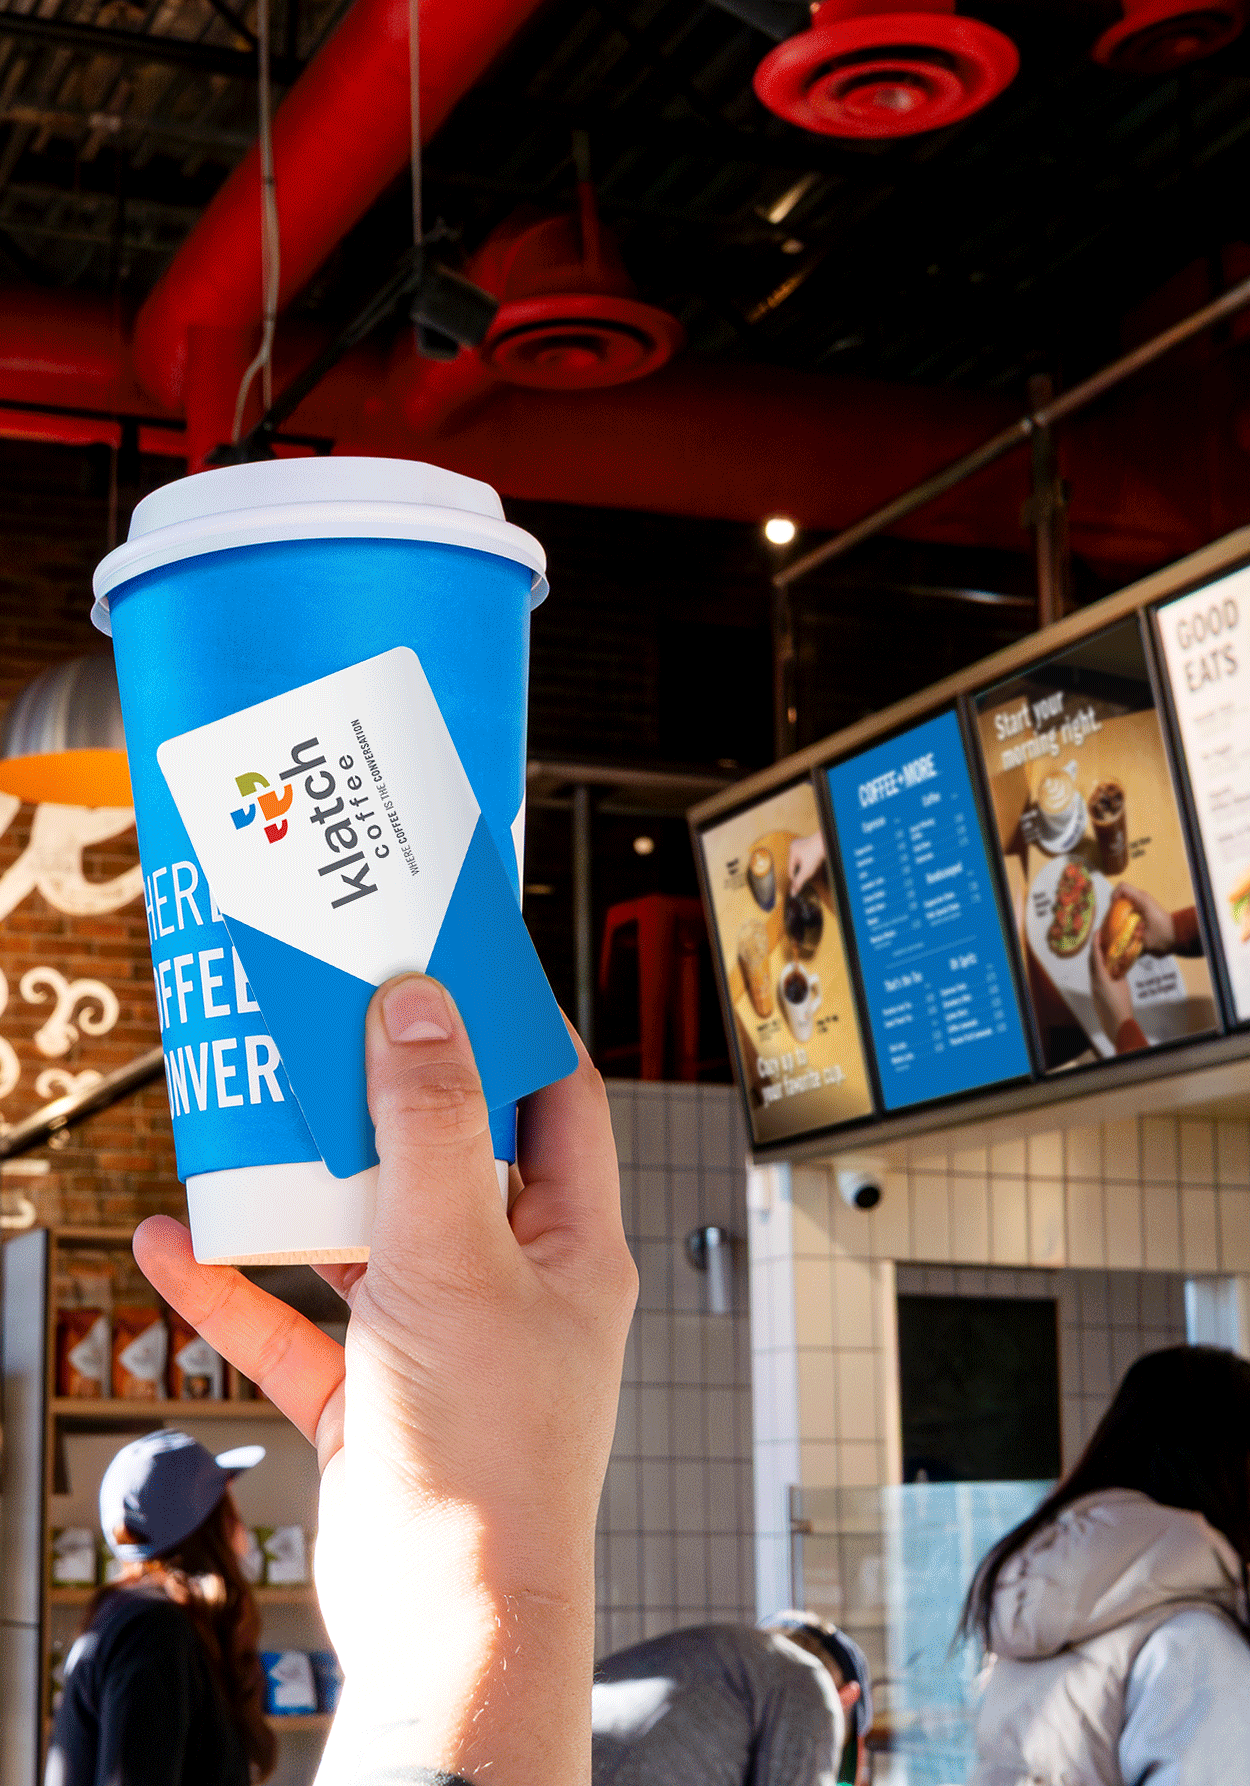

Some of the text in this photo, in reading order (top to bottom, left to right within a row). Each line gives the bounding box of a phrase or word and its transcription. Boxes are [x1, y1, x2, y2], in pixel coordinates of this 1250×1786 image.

[1177, 597, 1239, 650] GOOD
[1184, 644, 1238, 692] EATS
[995, 690, 1063, 740] Start your
[1002, 728, 1059, 771] morning
[279, 737, 378, 909] klatch
[339, 754, 390, 859] coffee
[350, 719, 420, 876] WHERE COFFEE IS THE CONVERSATION
